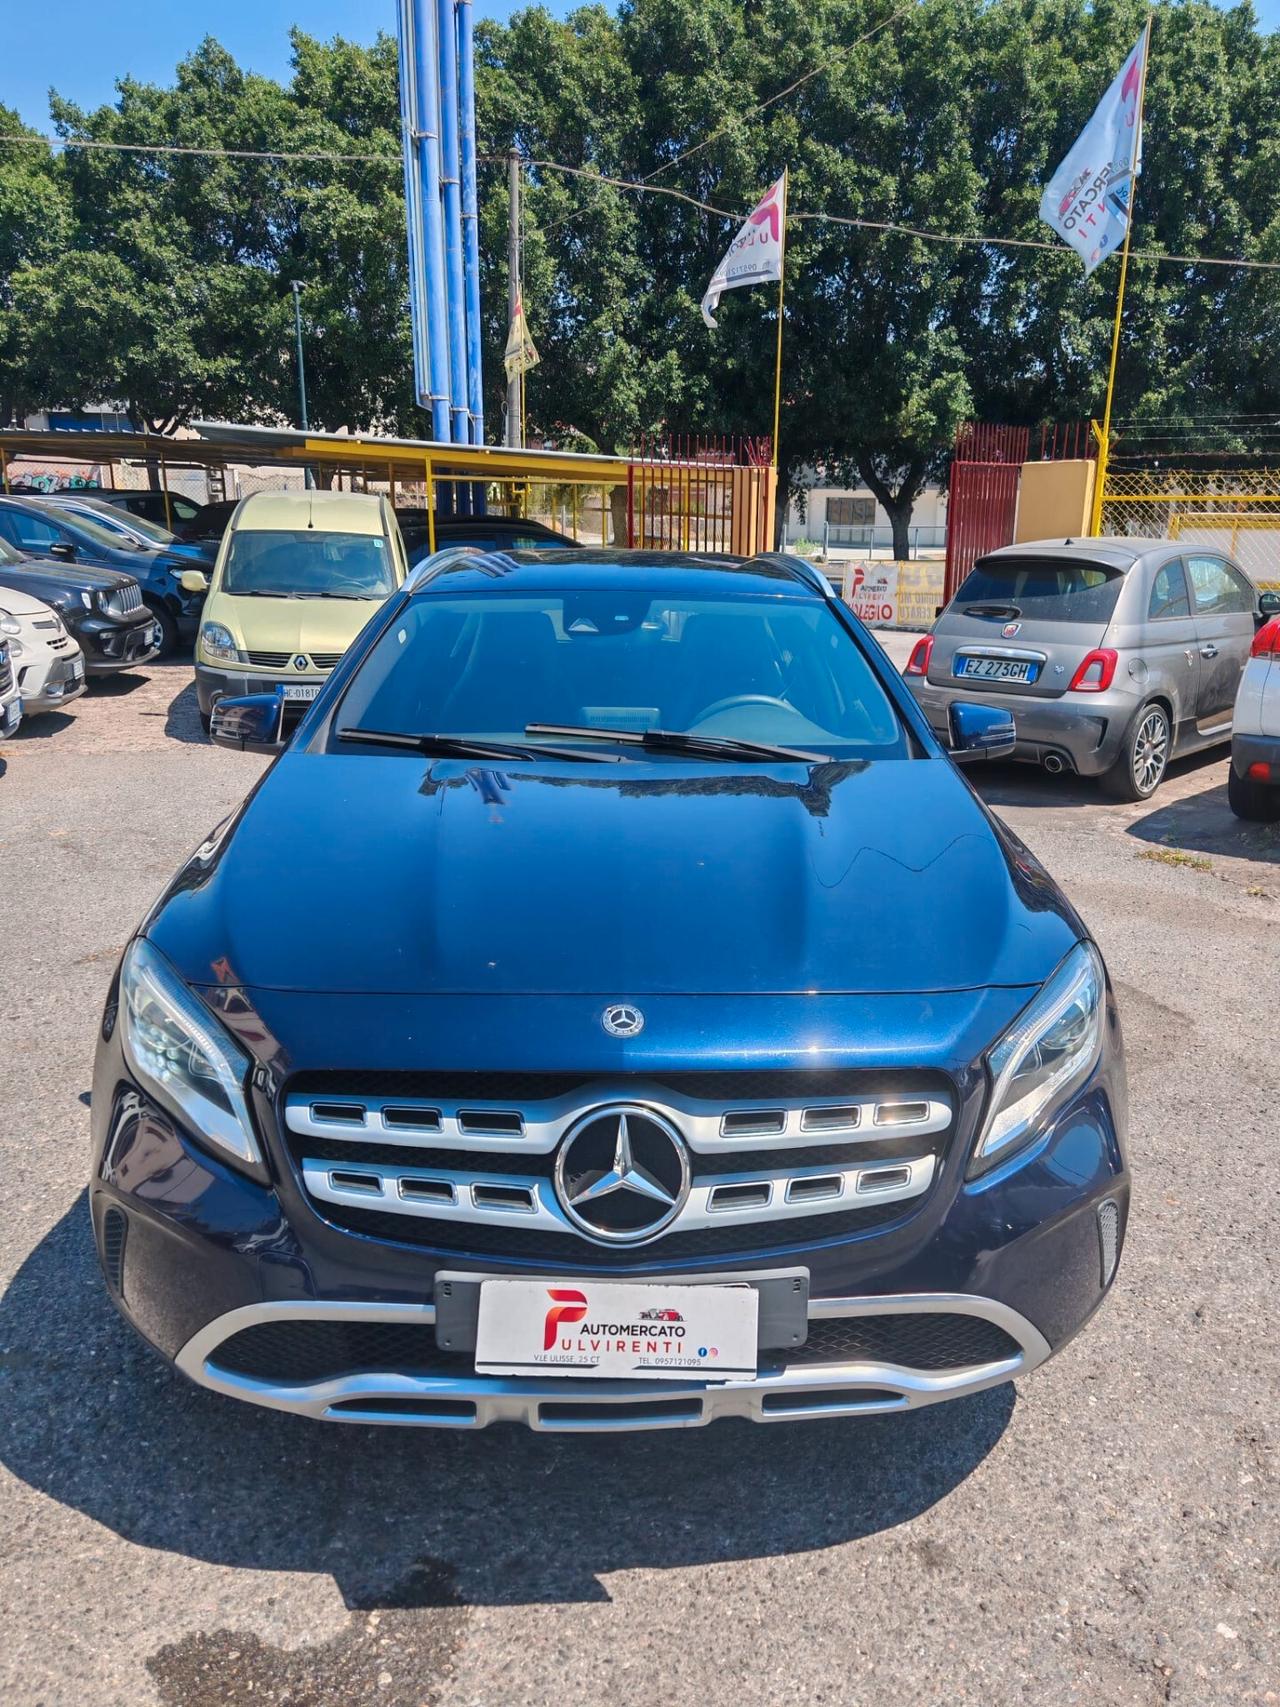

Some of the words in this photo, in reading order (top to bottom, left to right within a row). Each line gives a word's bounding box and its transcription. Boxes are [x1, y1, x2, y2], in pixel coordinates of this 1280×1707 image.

[965, 659, 982, 674] EZ
[985, 661, 1029, 679] 273GH
[580, 1323, 686, 1338] AUTOMERCATO
[578, 1355, 589, 1363] 25
[590, 1355, 600, 1363] CT
[655, 1357, 702, 1366] 0957121095
